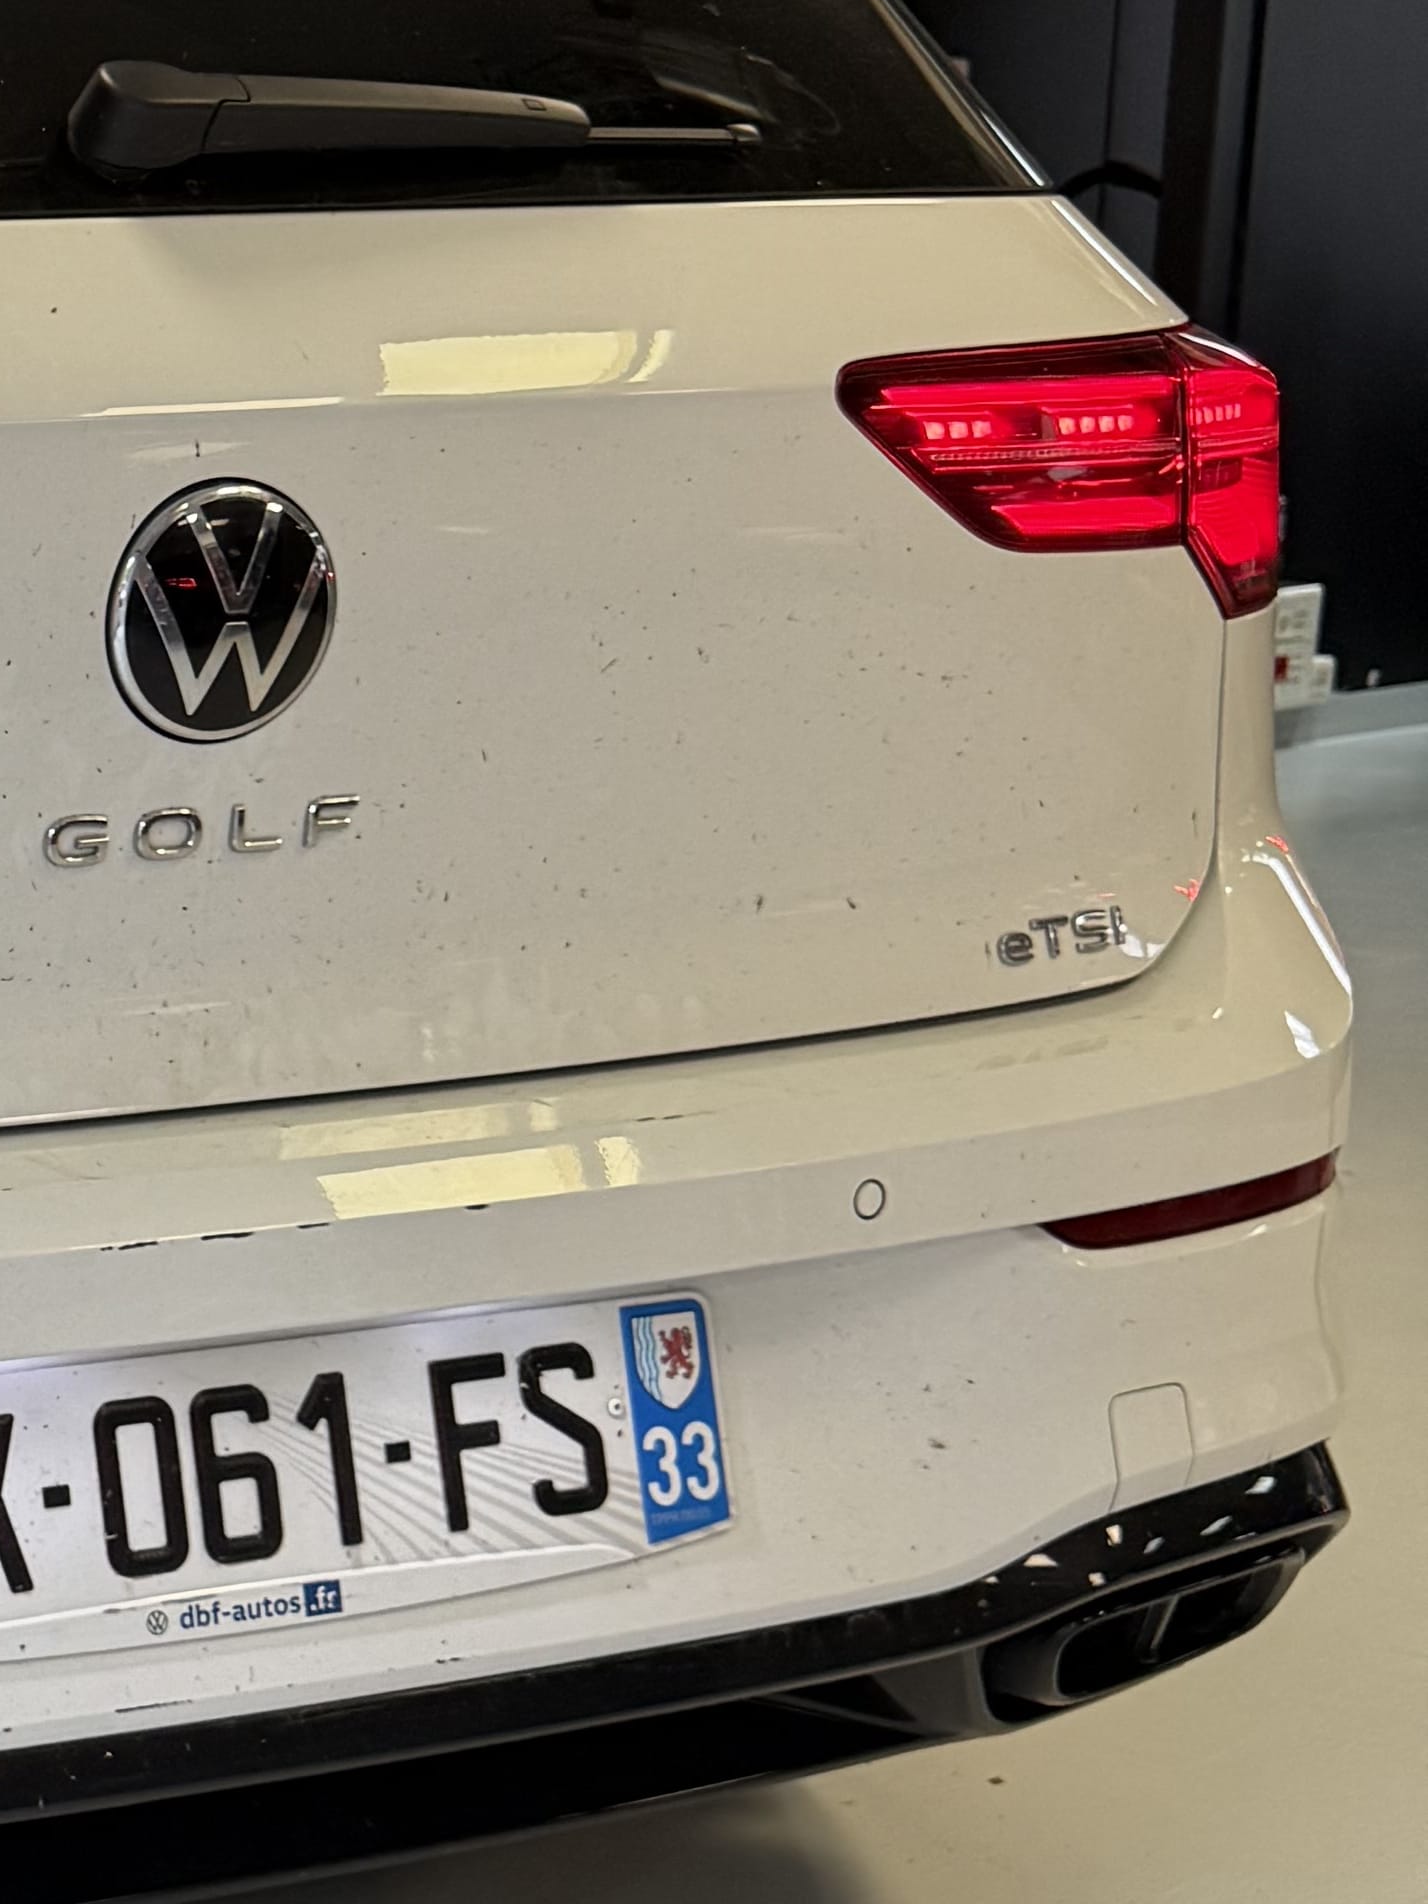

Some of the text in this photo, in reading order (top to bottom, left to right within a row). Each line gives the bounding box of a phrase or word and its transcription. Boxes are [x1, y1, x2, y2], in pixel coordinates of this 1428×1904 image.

[43, 794, 361, 868] GOLF
[997, 905, 1127, 966] eTSI
[643, 1420, 721, 1507] 33
